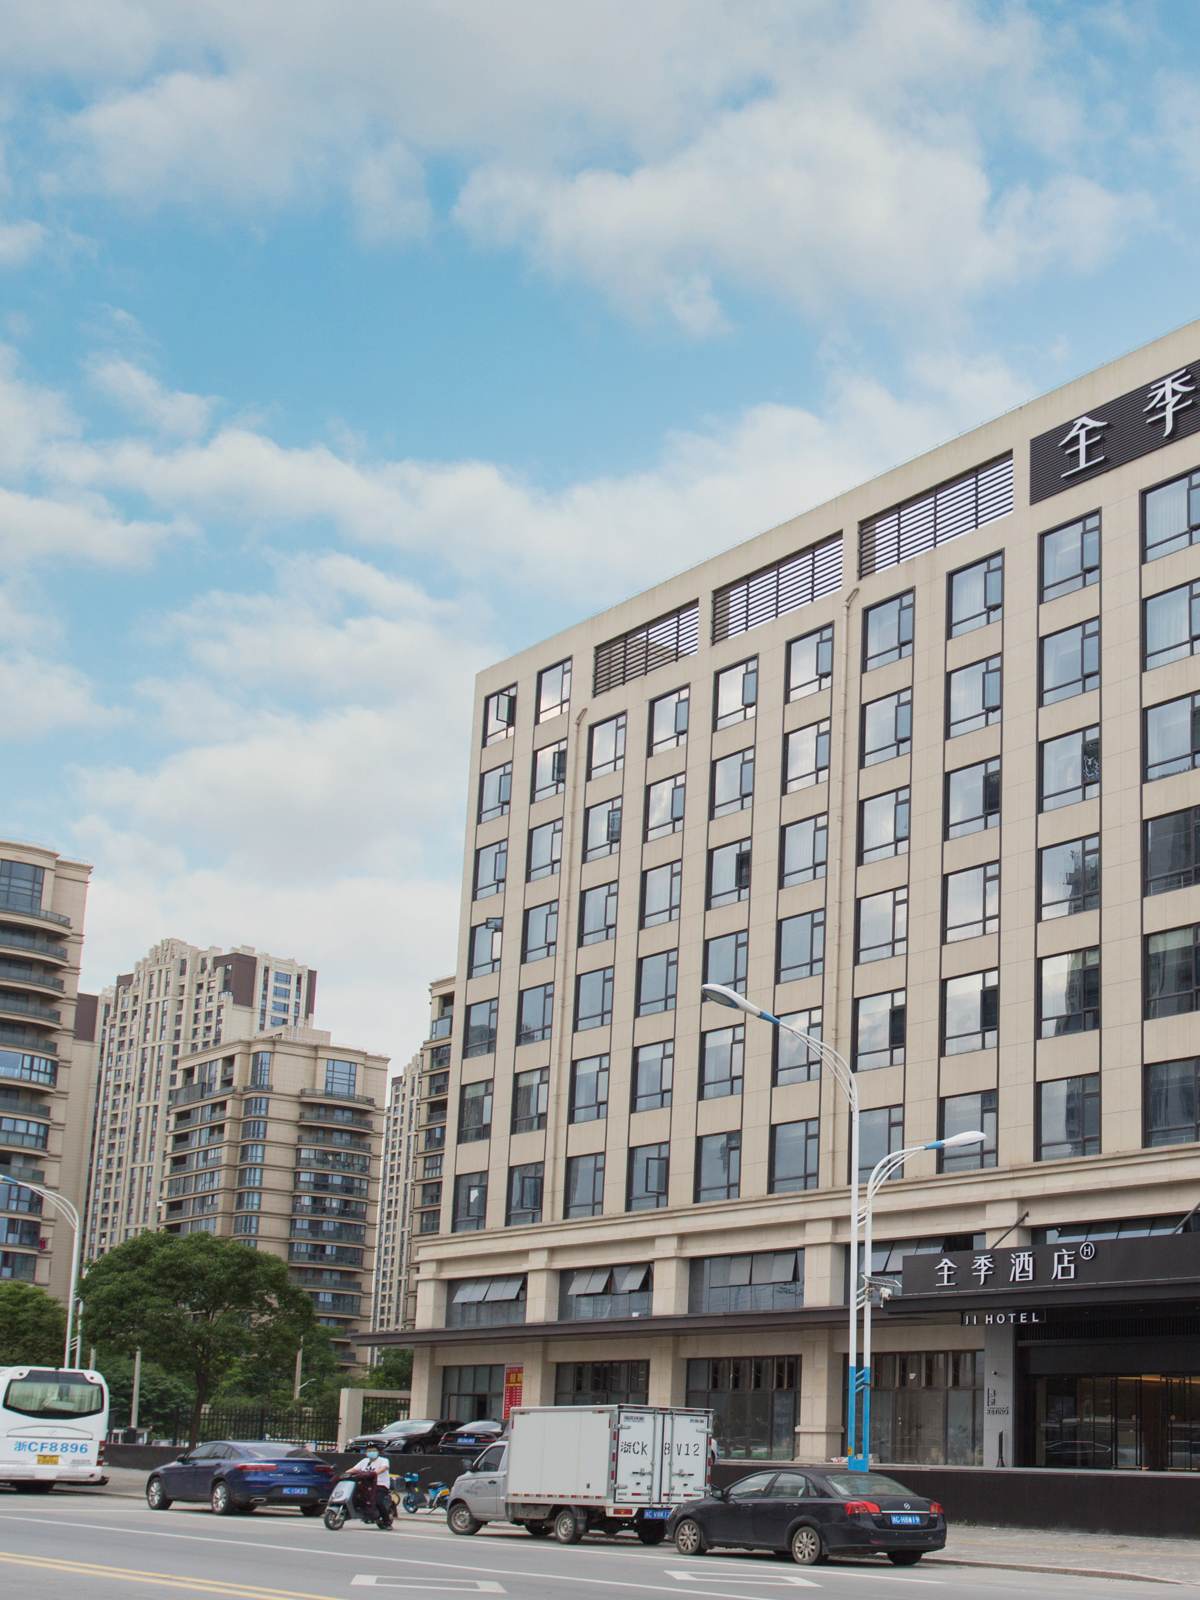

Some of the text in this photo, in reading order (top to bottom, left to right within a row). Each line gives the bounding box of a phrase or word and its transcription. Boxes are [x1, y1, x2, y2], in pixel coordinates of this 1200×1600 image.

[934, 1249, 1076, 1287] 全季酒店
[965, 1312, 1040, 1325] JI HOTEL
[13, 1440, 89, 1454] 浙CF8896
